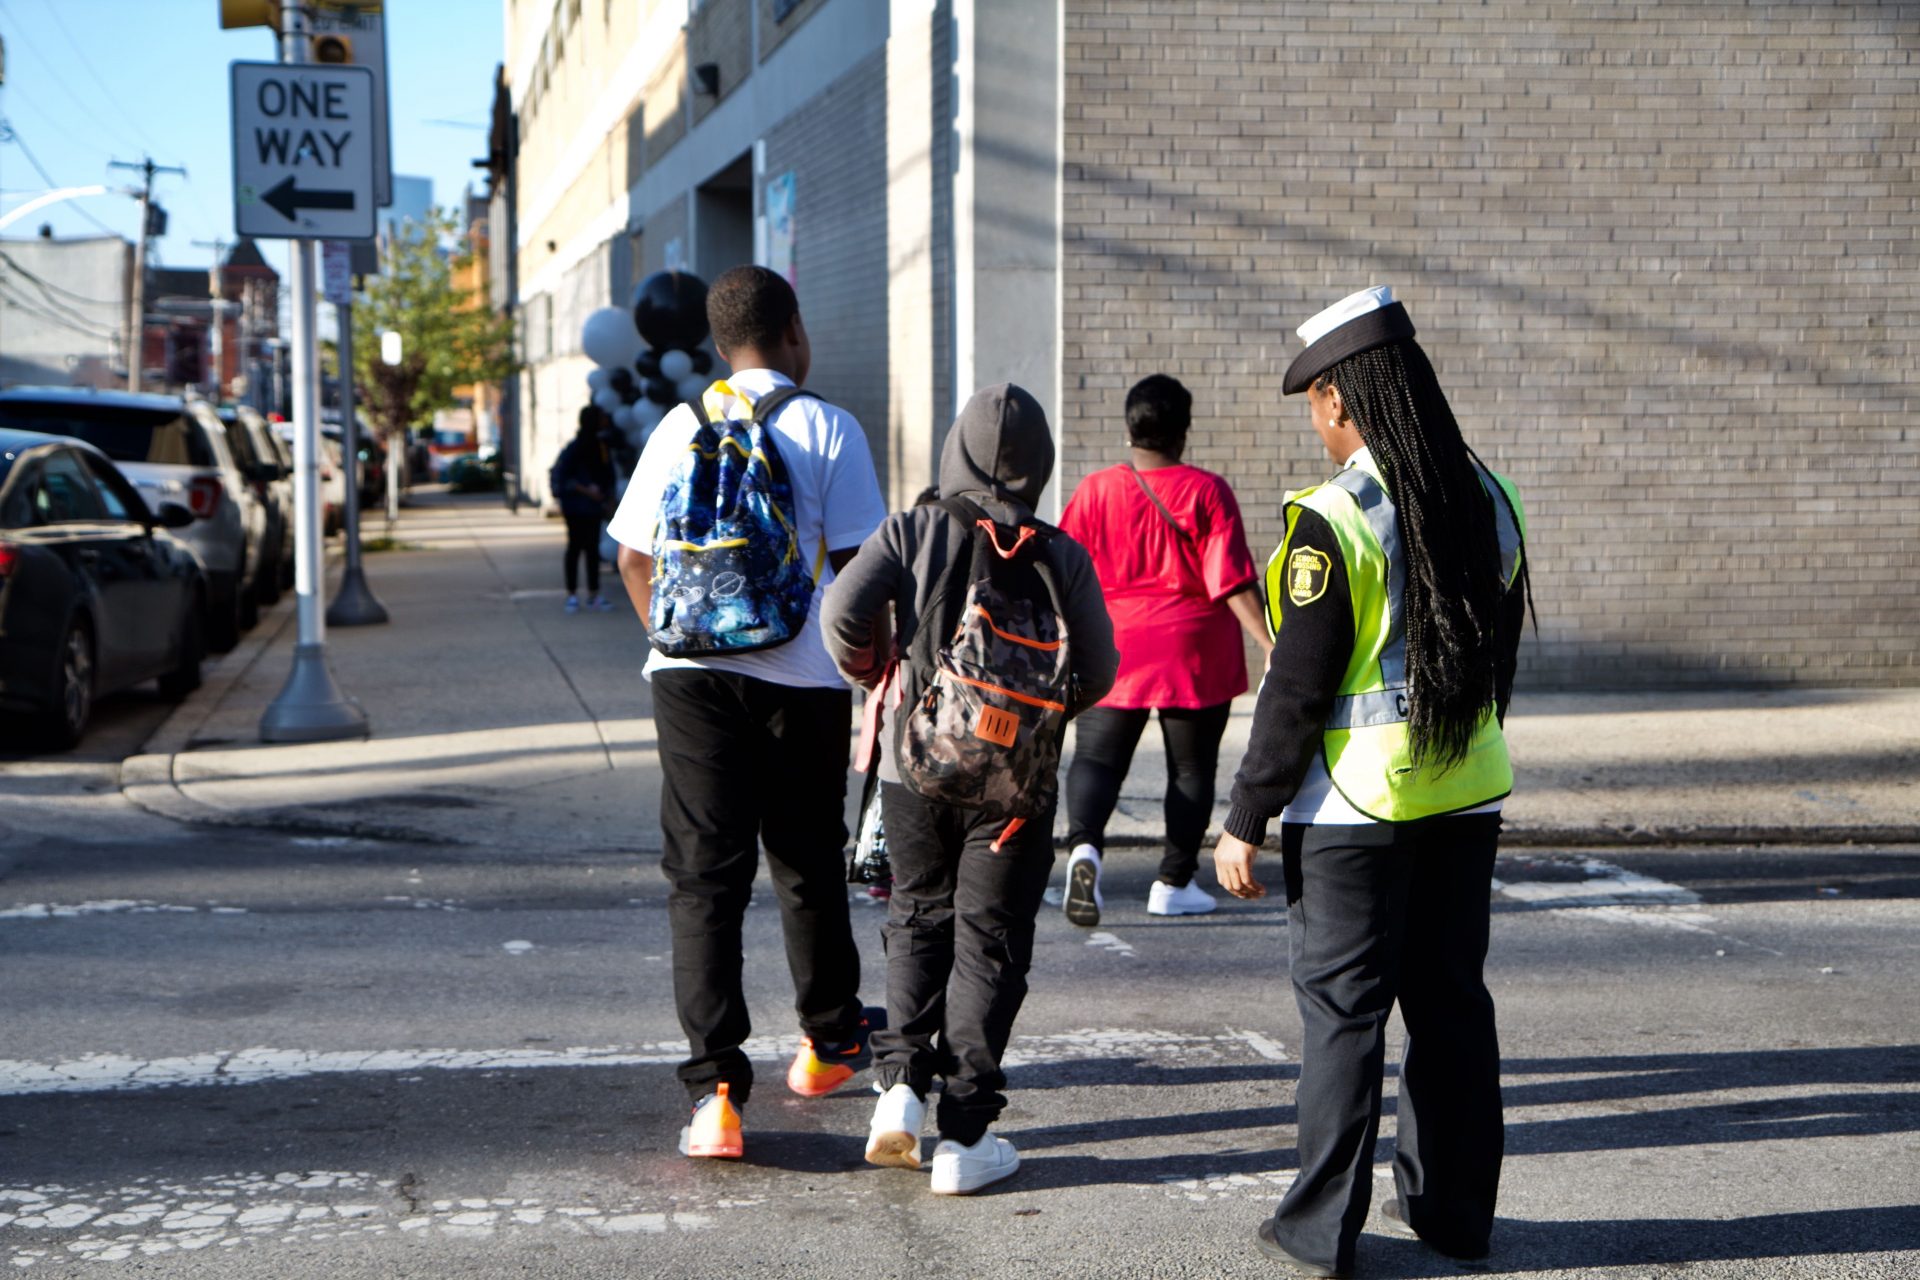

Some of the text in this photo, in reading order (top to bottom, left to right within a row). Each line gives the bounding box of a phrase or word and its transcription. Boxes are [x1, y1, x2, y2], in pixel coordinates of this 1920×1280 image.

[258, 79, 349, 119] ONE
[255, 128, 352, 168] WAY
[1295, 554, 1318, 562] SCHOOL
[1292, 561, 1322, 571] CROSSING
[1292, 588, 1312, 598] GUARD
